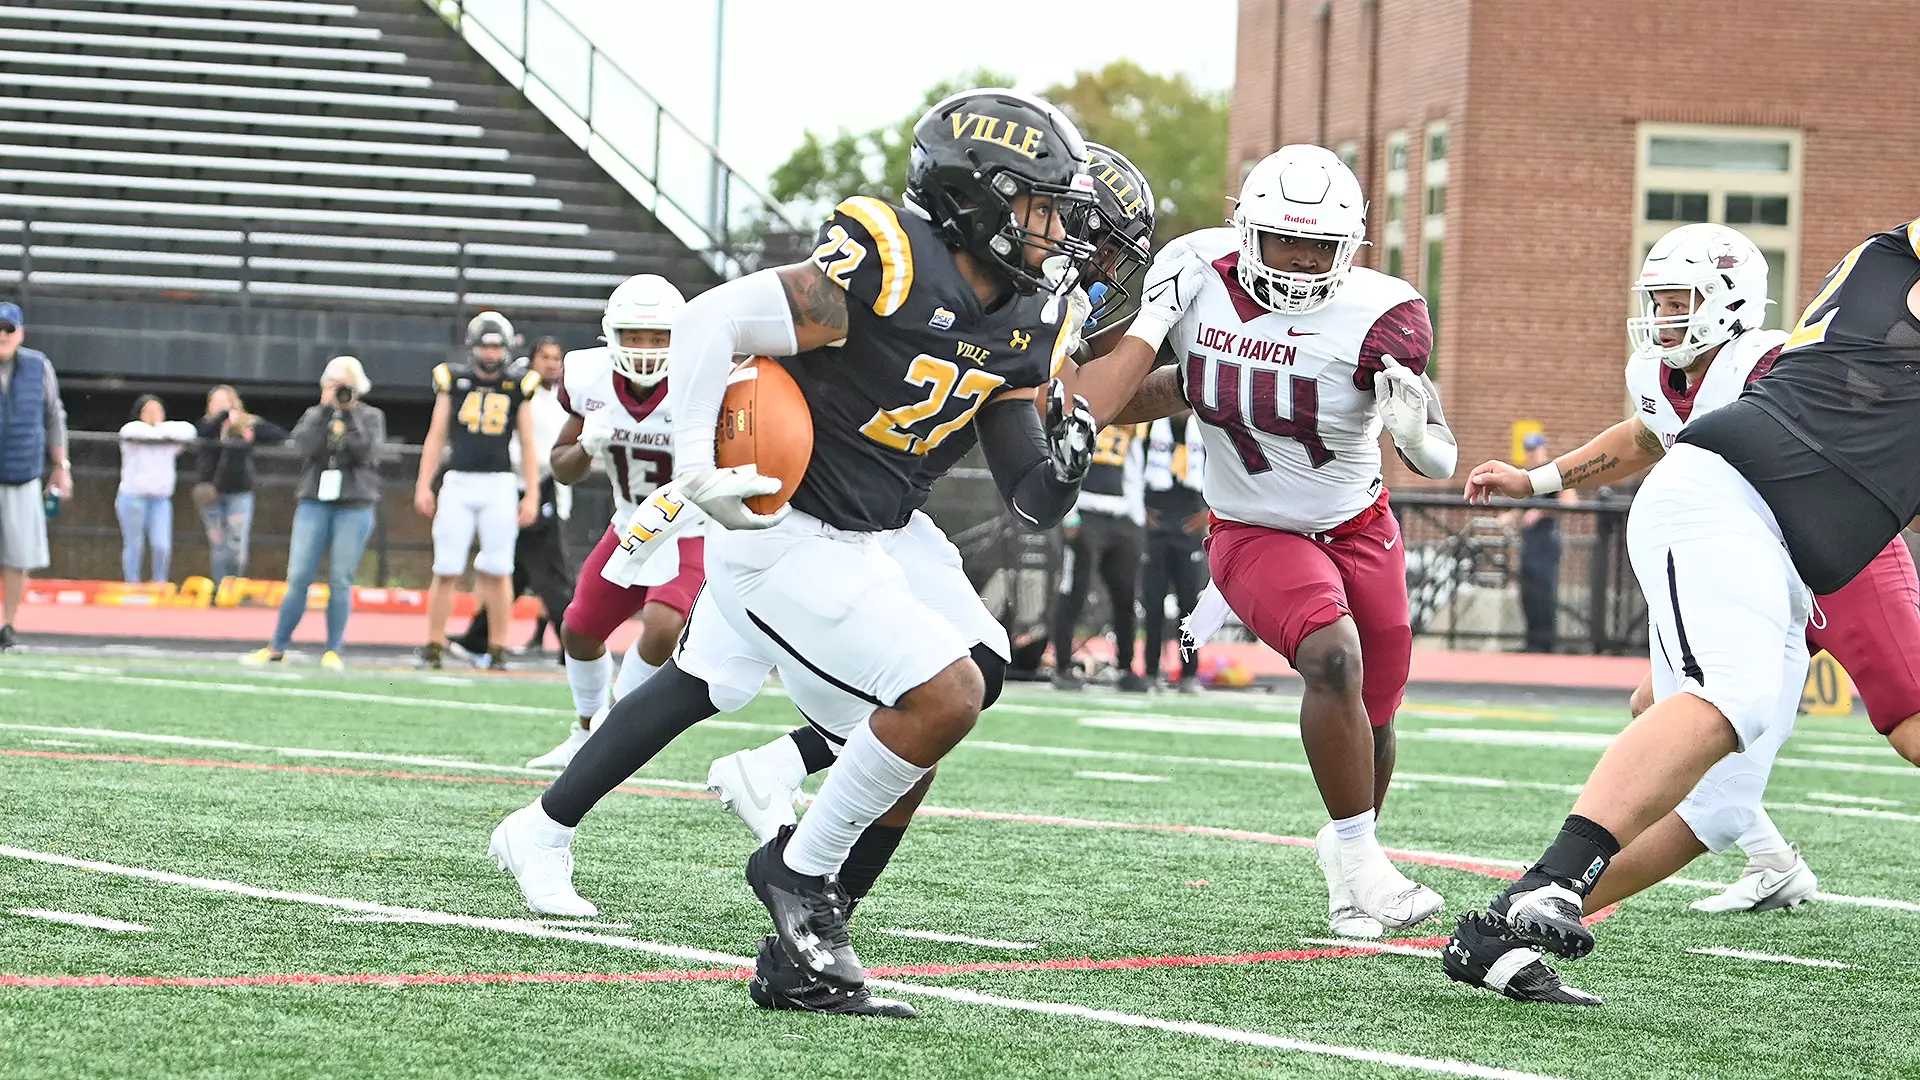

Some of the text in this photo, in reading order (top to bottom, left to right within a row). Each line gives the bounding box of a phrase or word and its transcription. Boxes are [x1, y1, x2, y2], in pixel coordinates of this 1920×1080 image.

[950, 112, 1044, 160] VILLE
[1087, 152, 1146, 220] VILLE
[1284, 214, 1317, 225] Riddell
[811, 225, 867, 290] 22
[956, 340, 990, 366] VILLE
[1196, 323, 1297, 366] LOCK HAVEN
[737, 409, 745, 432] NCAA
[1186, 350, 1337, 475] 44
[612, 427, 671, 446] OCK HAVEN
[608, 444, 673, 506] 13
